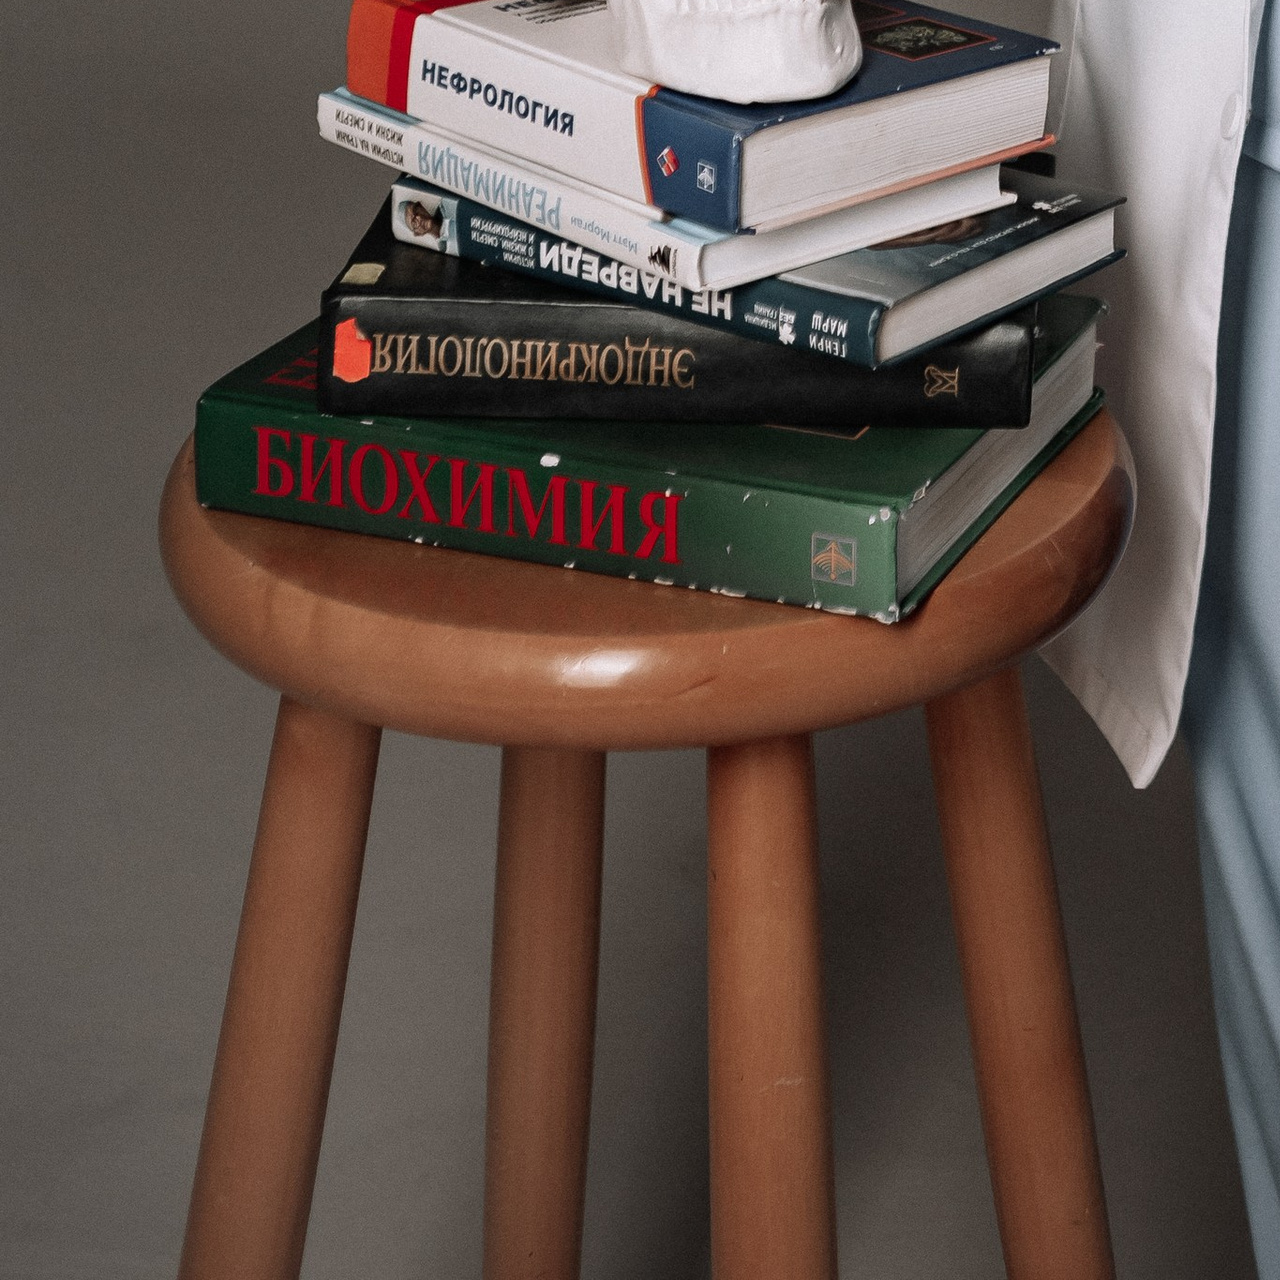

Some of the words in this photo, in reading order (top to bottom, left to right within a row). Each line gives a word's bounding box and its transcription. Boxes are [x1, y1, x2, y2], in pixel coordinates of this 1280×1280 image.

[421, 59, 575, 137] НЕФРОЛОГИЯ
[335, 109, 365, 132] СМЕРТИ
[367, 121, 374, 134] И
[335, 128, 358, 149] ГРАНИ
[359, 139, 370, 154] НА
[375, 124, 404, 147] ЖИЗНИ
[371, 143, 404, 167] ИСТОРИИ
[416, 140, 562, 231] РЕАНИМАЦИЯ
[470, 216, 528, 243] НЕЙРОХИРУРГИИ
[471, 230, 499, 247] СМЕРТИ
[570, 216, 610, 242] Морган
[503, 252, 536, 269] ИСТОРИИ
[528, 245, 535, 257] О
[540, 240, 683, 307] НАВРЕДИ
[691, 290, 733, 321] НЕ
[811, 313, 848, 338] МАРШ
[809, 334, 847, 358] ГЕНРИ
[371, 332, 695, 390] ЭНДОКРИНОЛОГИЯ
[252, 426, 683, 565] БИОХИМИЯ
